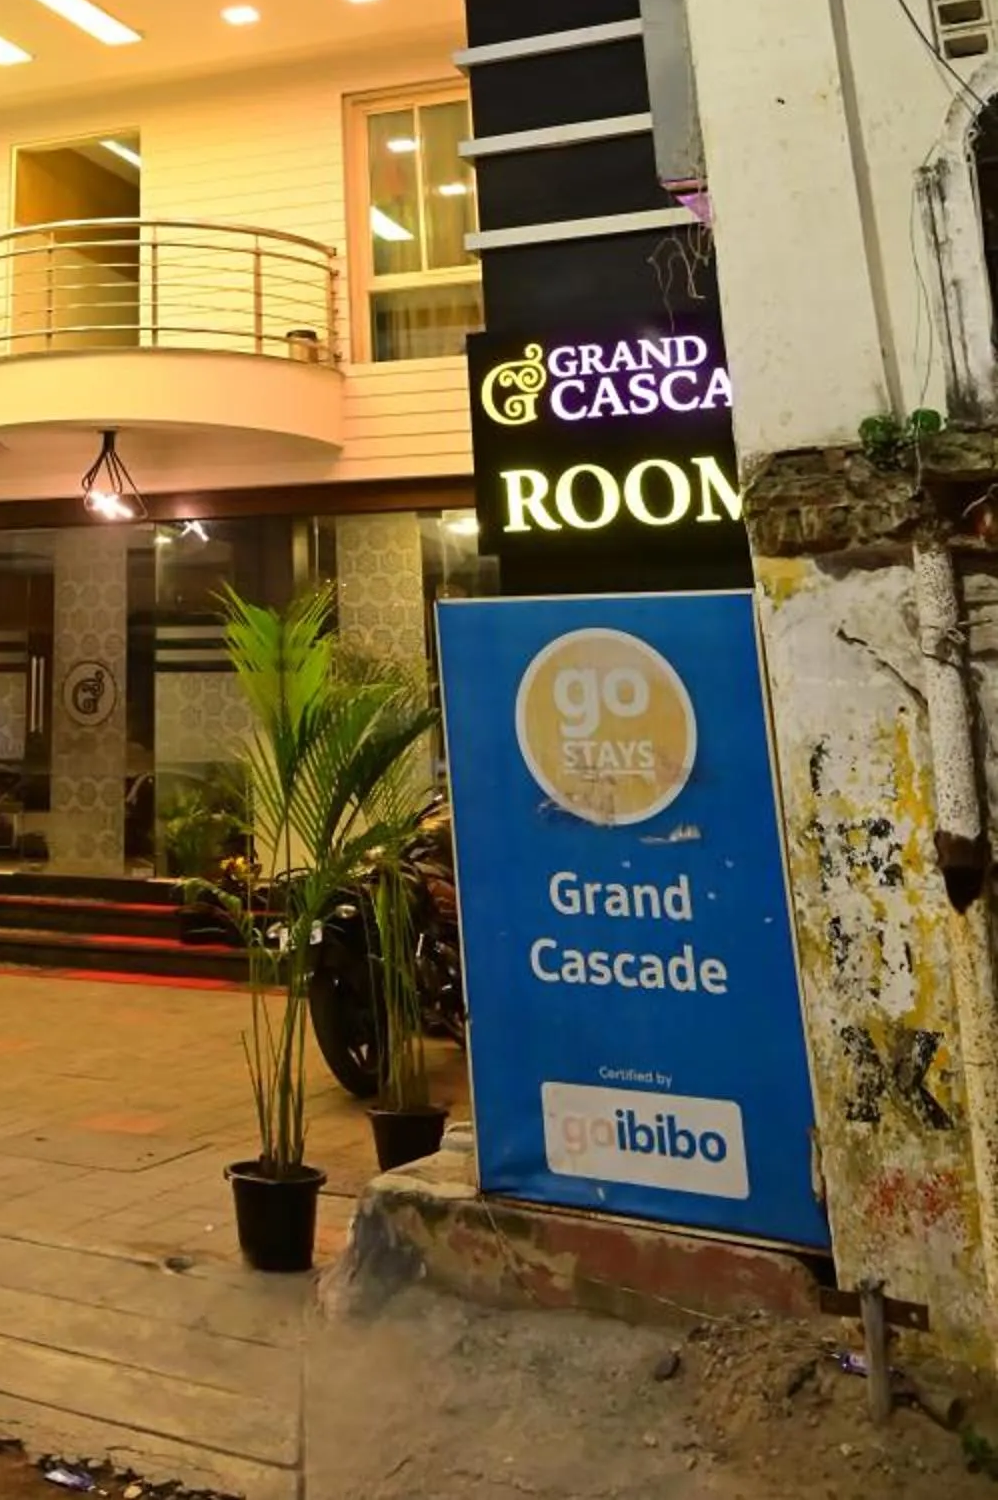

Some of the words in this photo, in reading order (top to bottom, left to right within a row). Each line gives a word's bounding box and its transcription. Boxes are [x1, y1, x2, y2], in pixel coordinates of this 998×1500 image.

[548, 335, 707, 378] GRAND
[553, 667, 650, 738] go
[563, 740, 655, 770] STAYS
[549, 871, 692, 921] Grand
[530, 938, 728, 994] Cascade
[657, 1071, 673, 1089] by
[561, 1109, 727, 1163] goibibo
